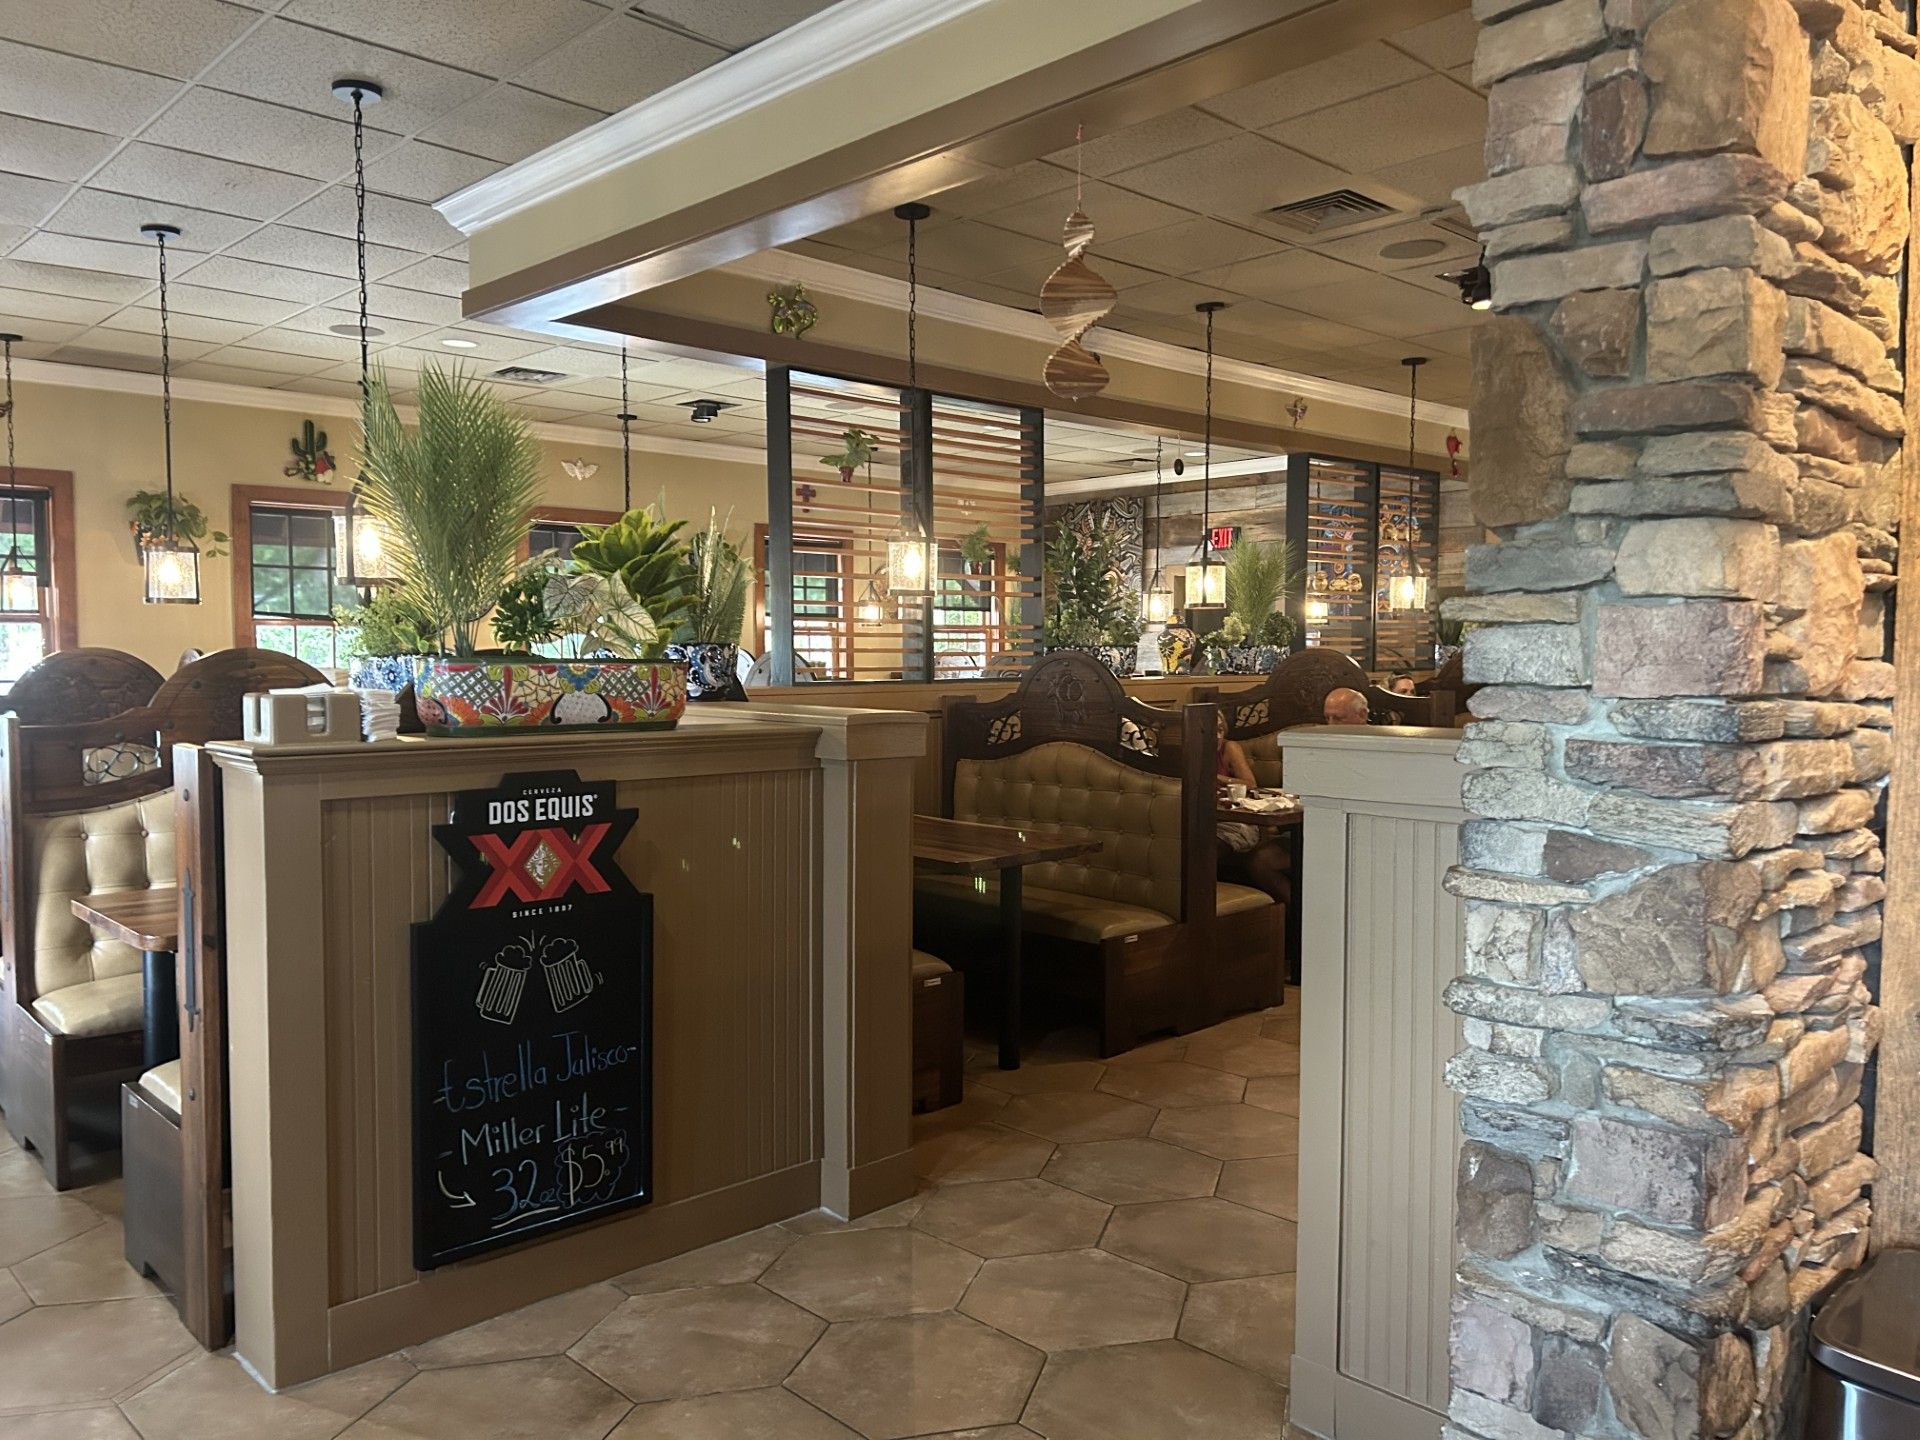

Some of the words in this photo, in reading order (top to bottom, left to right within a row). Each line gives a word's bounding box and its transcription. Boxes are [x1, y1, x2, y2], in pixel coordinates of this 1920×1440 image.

[1211, 527, 1233, 548] EXIT
[522, 787, 562, 796] CERVEZA
[488, 800, 529, 825] DOS
[535, 794, 594, 821] EQUIS
[512, 908, 543, 918] SINCE
[461, 1117, 545, 1165] Miller
[553, 1092, 606, 1142] Lite
